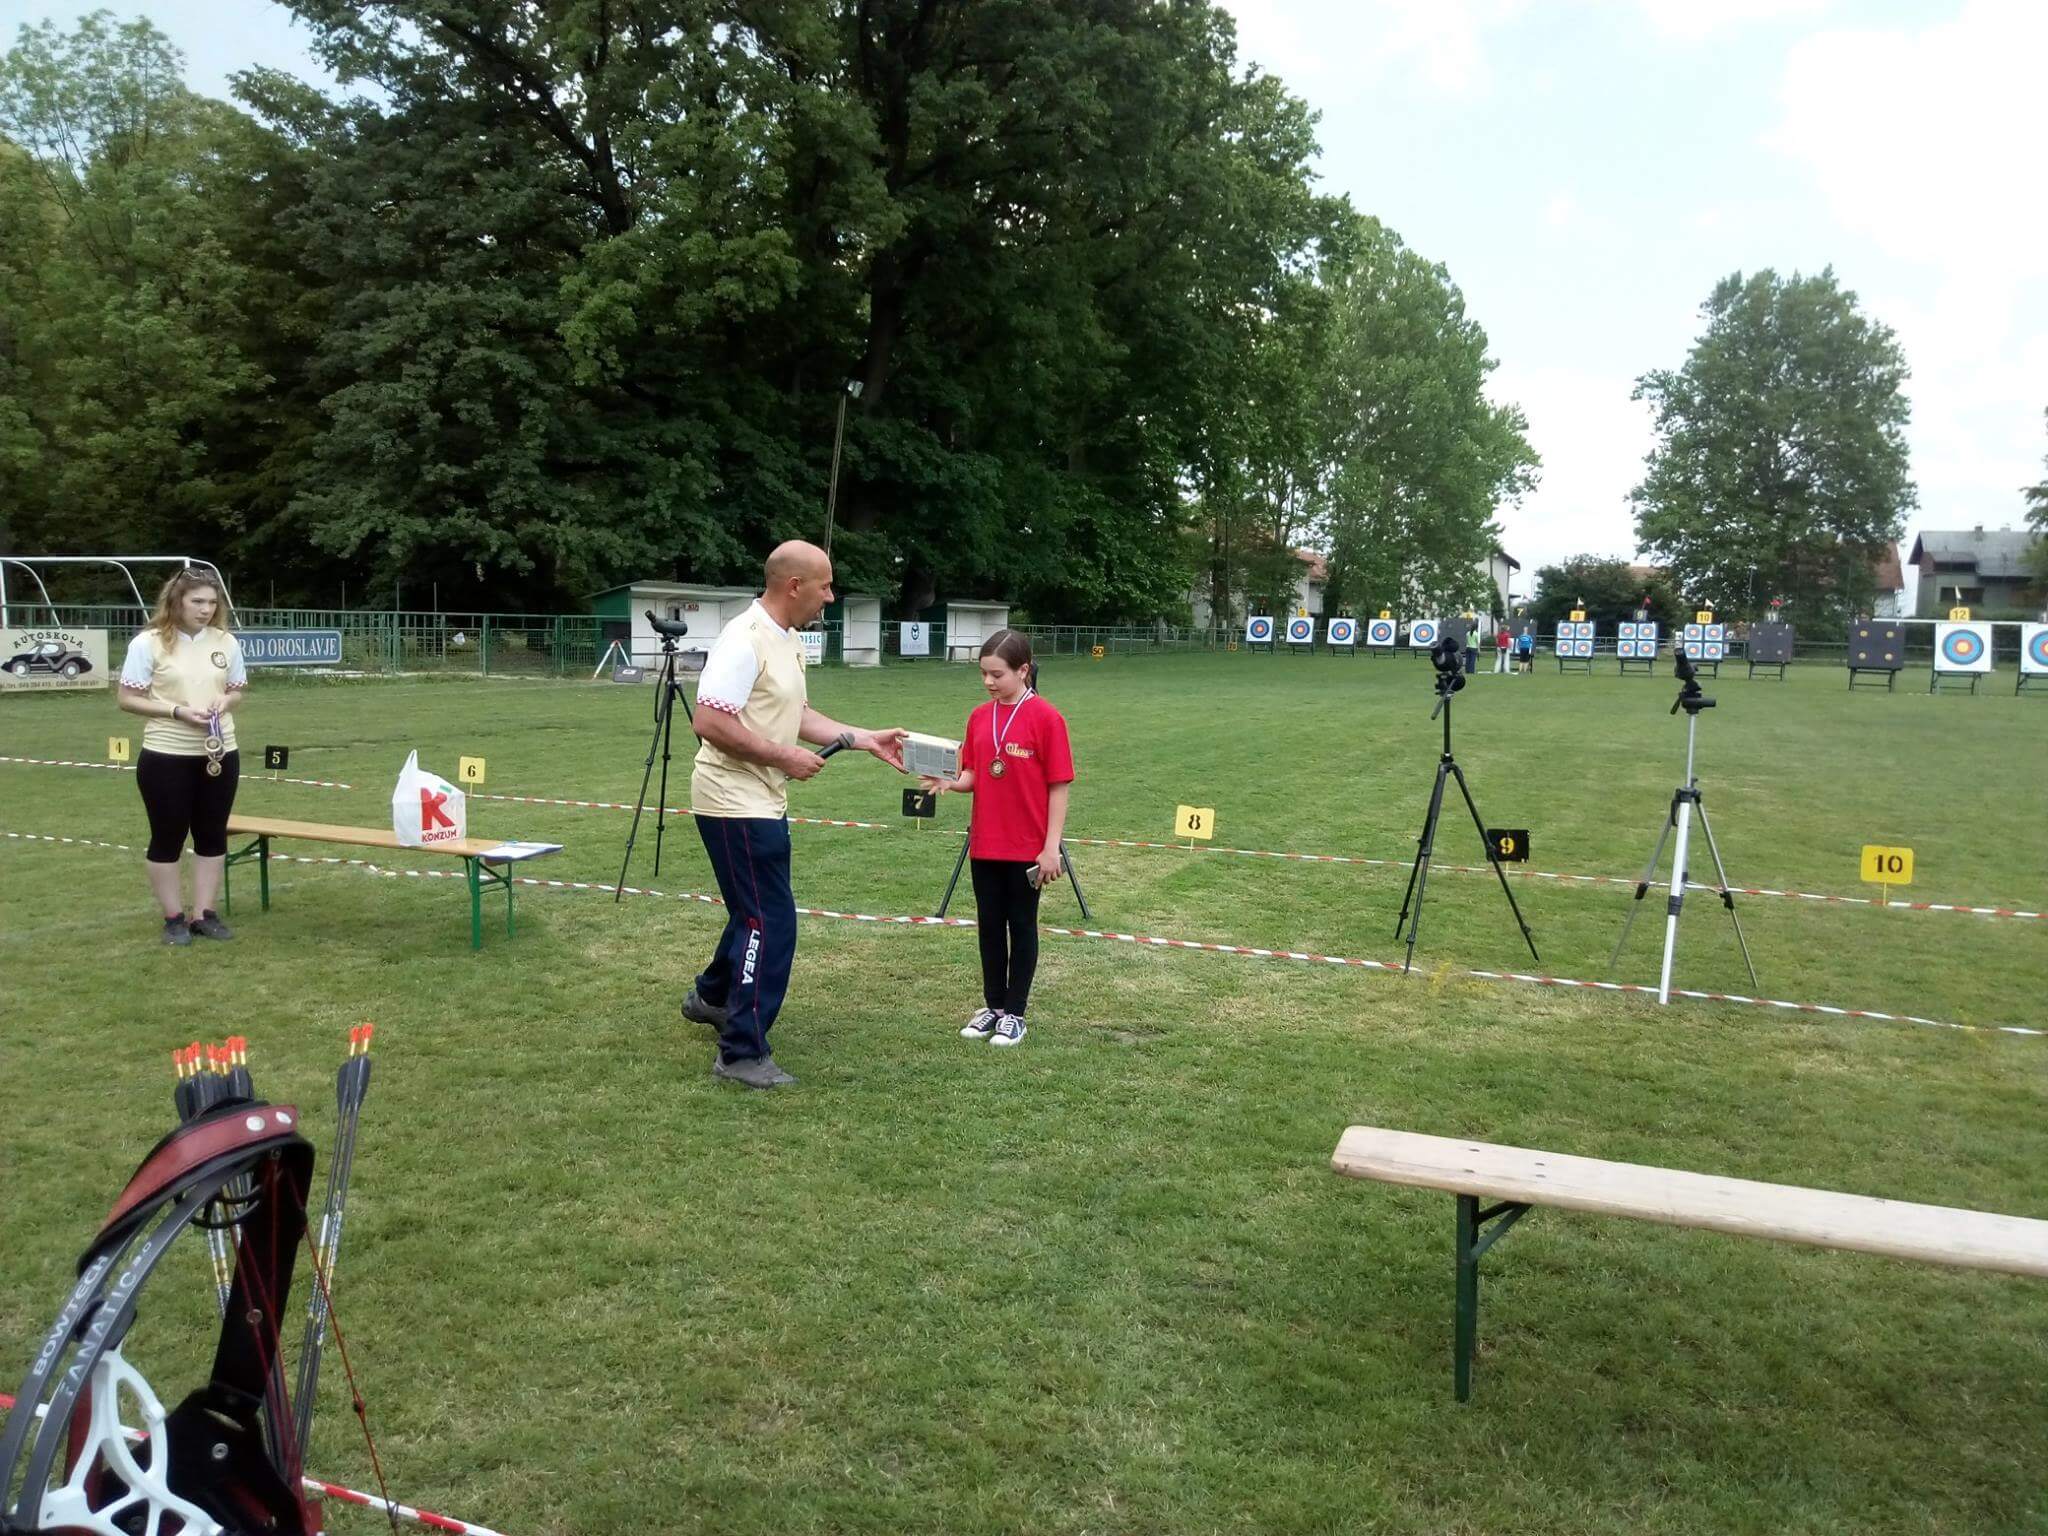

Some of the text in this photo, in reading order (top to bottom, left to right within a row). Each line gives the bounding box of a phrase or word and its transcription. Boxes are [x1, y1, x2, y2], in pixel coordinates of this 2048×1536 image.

[1767, 612, 1777, 621] 11
[1953, 610, 1967, 620] 12
[240, 638, 337, 657] RAD OROSLAVJE
[272, 751, 281, 765] 5
[467, 764, 476, 778] 6
[913, 795, 925, 810] 7
[1188, 814, 1201, 830] 8
[422, 830, 457, 843] KONZUM
[1500, 837, 1514, 855] 9
[1874, 854, 1903, 874] 10
[742, 929, 761, 985] LEGEA
[33, 1255, 109, 1377] BOWTECH
[58, 1271, 137, 1397] FANATIC
